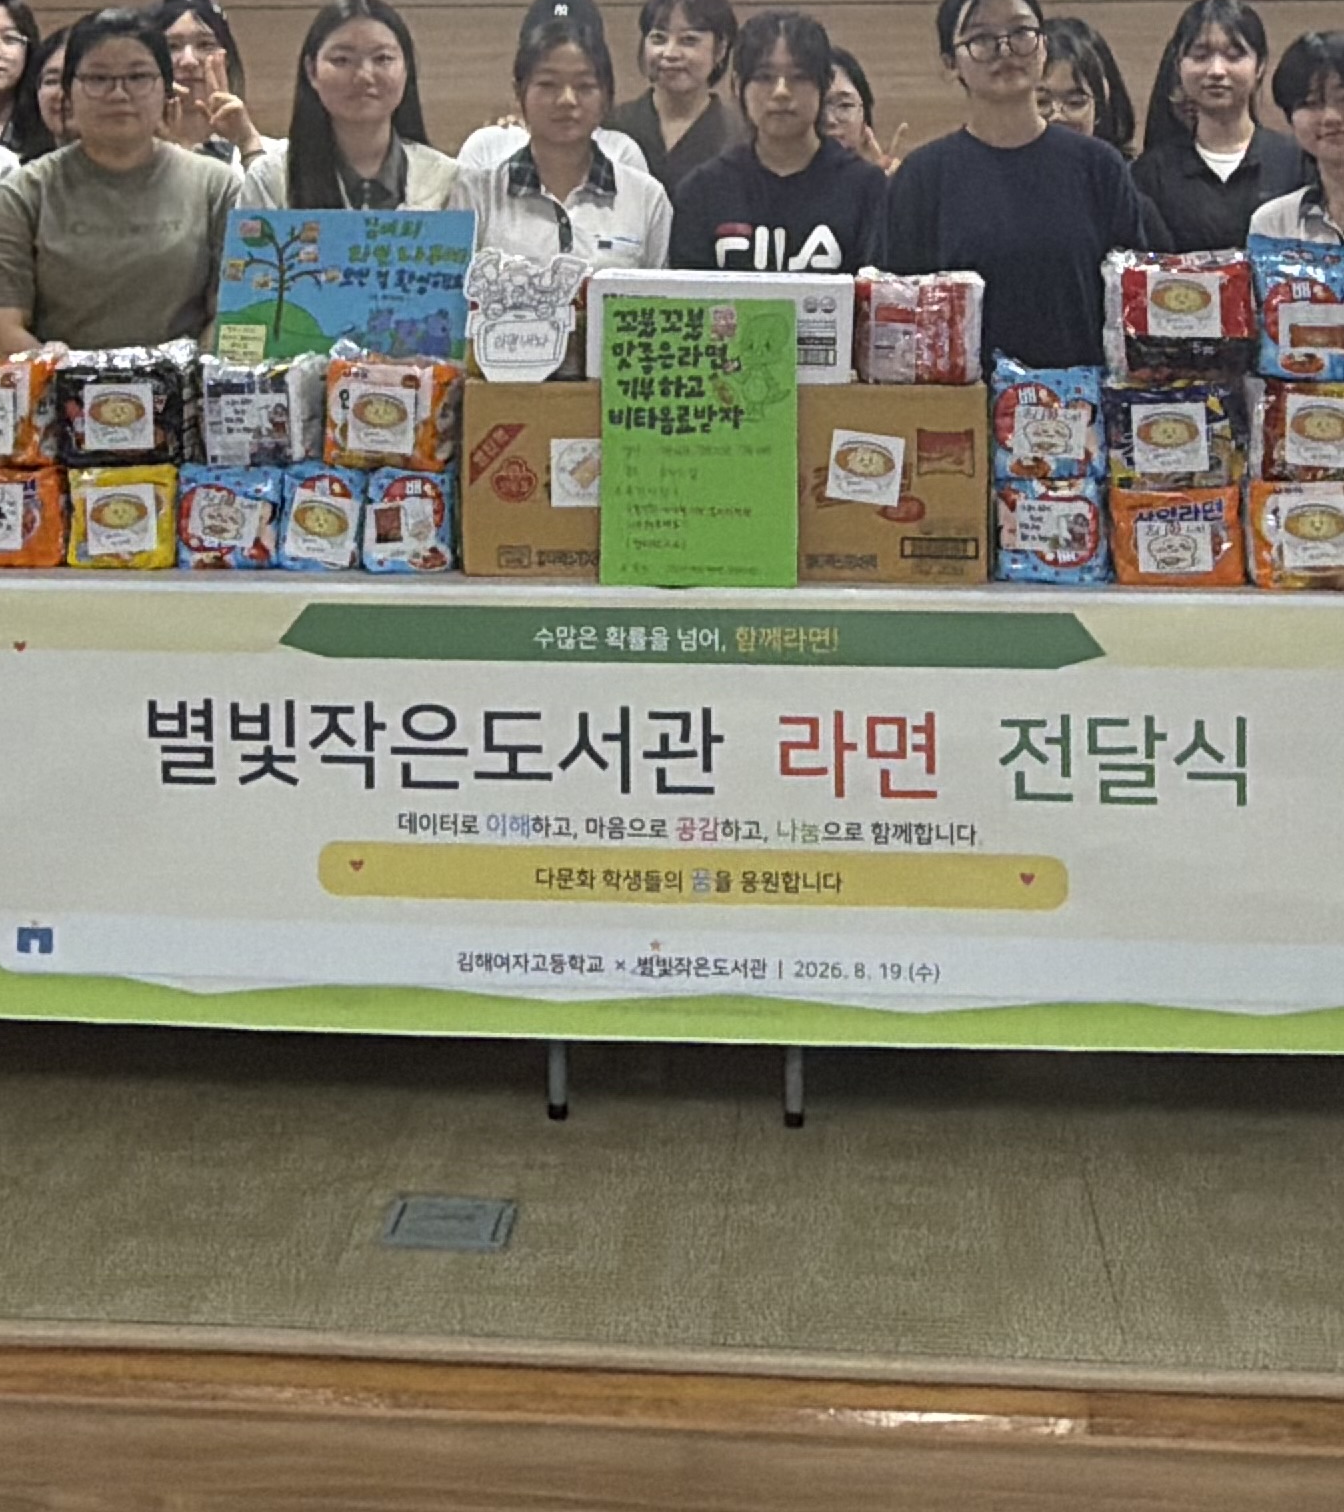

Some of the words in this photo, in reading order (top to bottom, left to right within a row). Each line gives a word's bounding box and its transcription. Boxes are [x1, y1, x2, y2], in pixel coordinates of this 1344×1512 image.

[715, 221, 843, 271] FILA
[533, 626, 598, 650] 수많은
[605, 626, 670, 652] 확률을
[677, 627, 726, 653] 넘어,
[147, 698, 725, 796] 별빛작은도서관
[778, 710, 938, 799] 라면
[999, 714, 1248, 807] 전달식
[397, 812, 480, 836] 데이터로
[486, 813, 579, 839] 이해하고,
[585, 816, 669, 840] 마음으로
[675, 817, 769, 843] 공감하고,
[777, 818, 865, 844] 나눔으로
[535, 867, 595, 890] 다문화
[602, 869, 683, 893] 학생들의
[740, 870, 843, 895] 응원합니다
[456, 952, 605, 975] 김해여자고등학교
[636, 956, 768, 980] 별빛작은도서관
